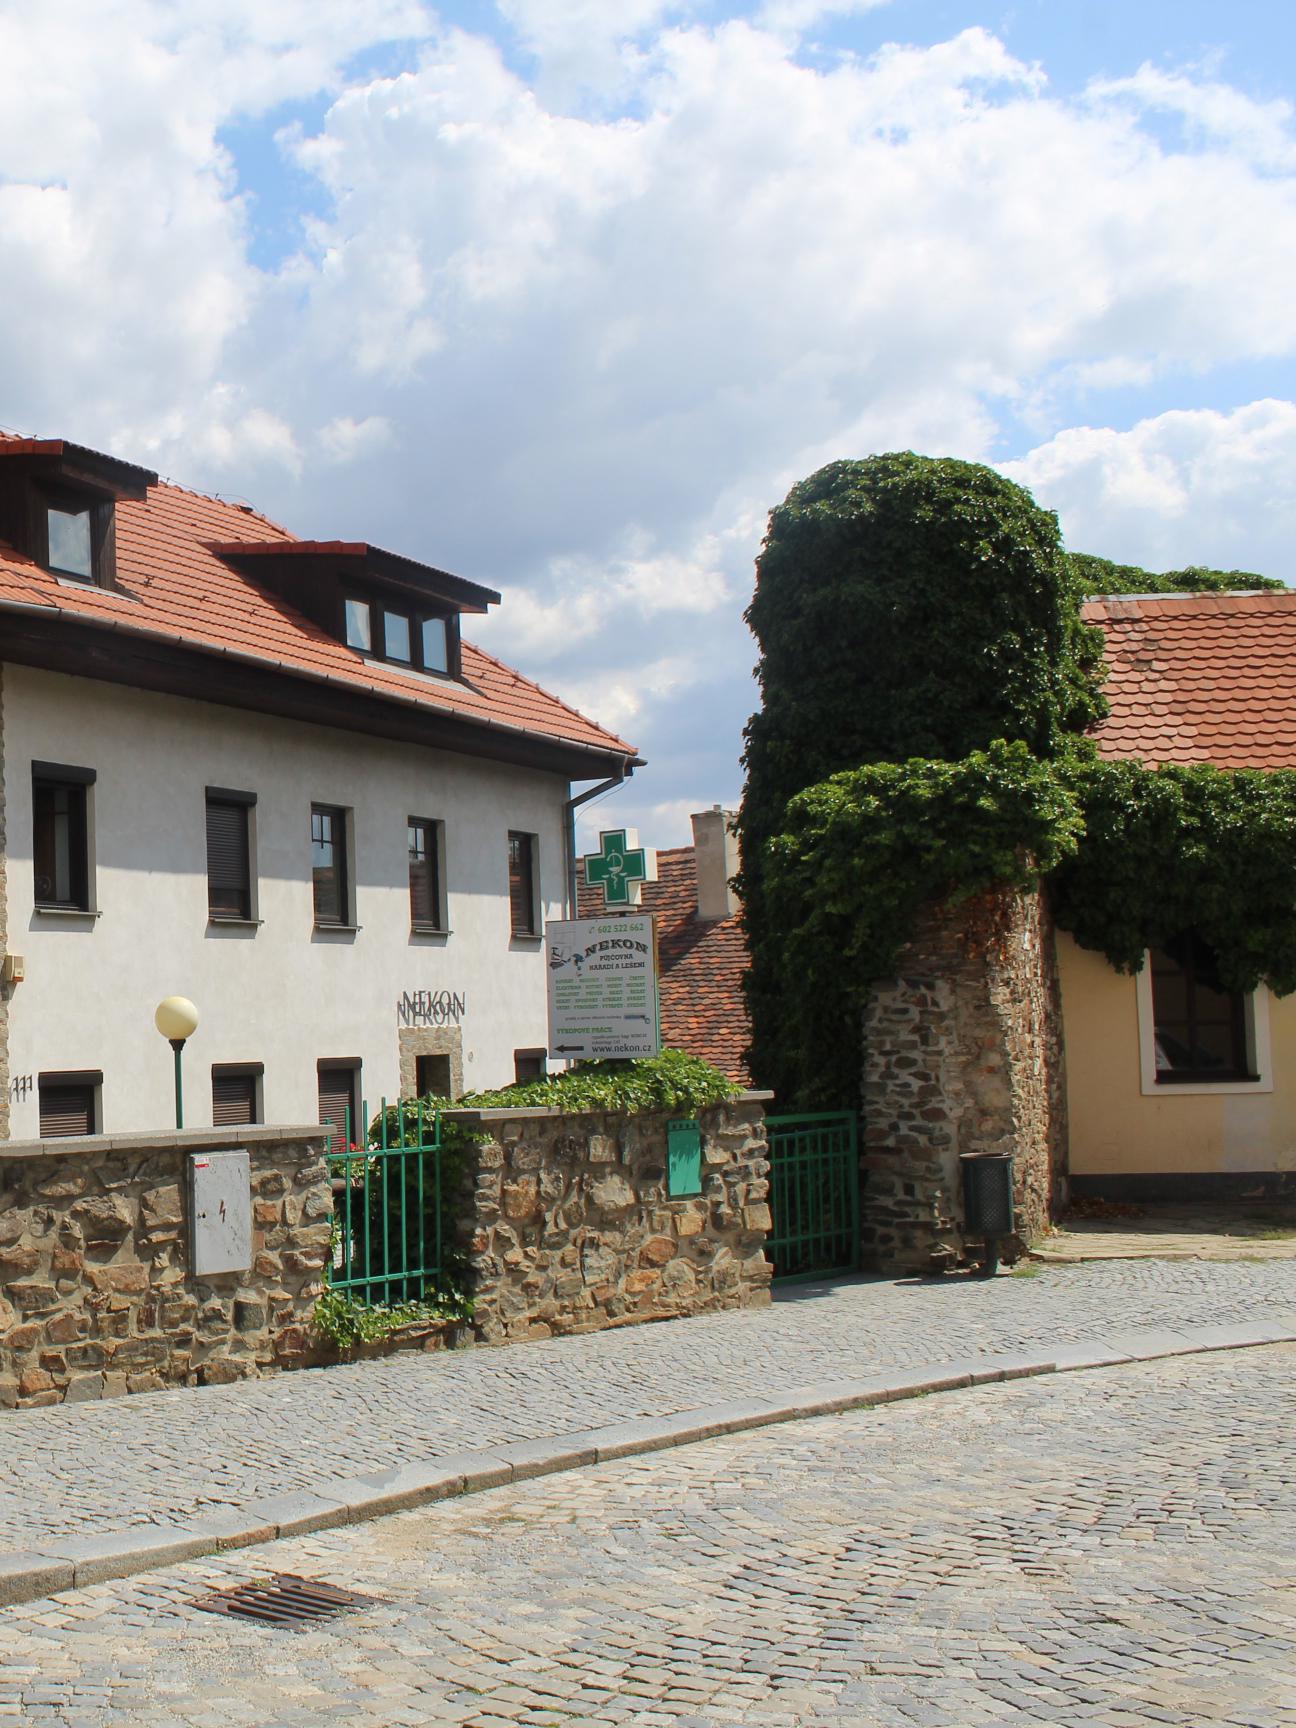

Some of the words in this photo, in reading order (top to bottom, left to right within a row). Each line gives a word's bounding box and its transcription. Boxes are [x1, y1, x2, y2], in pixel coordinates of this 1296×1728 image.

[585, 939, 648, 958] NEKON
[402, 990, 465, 1016] NEKON
[592, 1044, 651, 1053] www.nekon.cz
